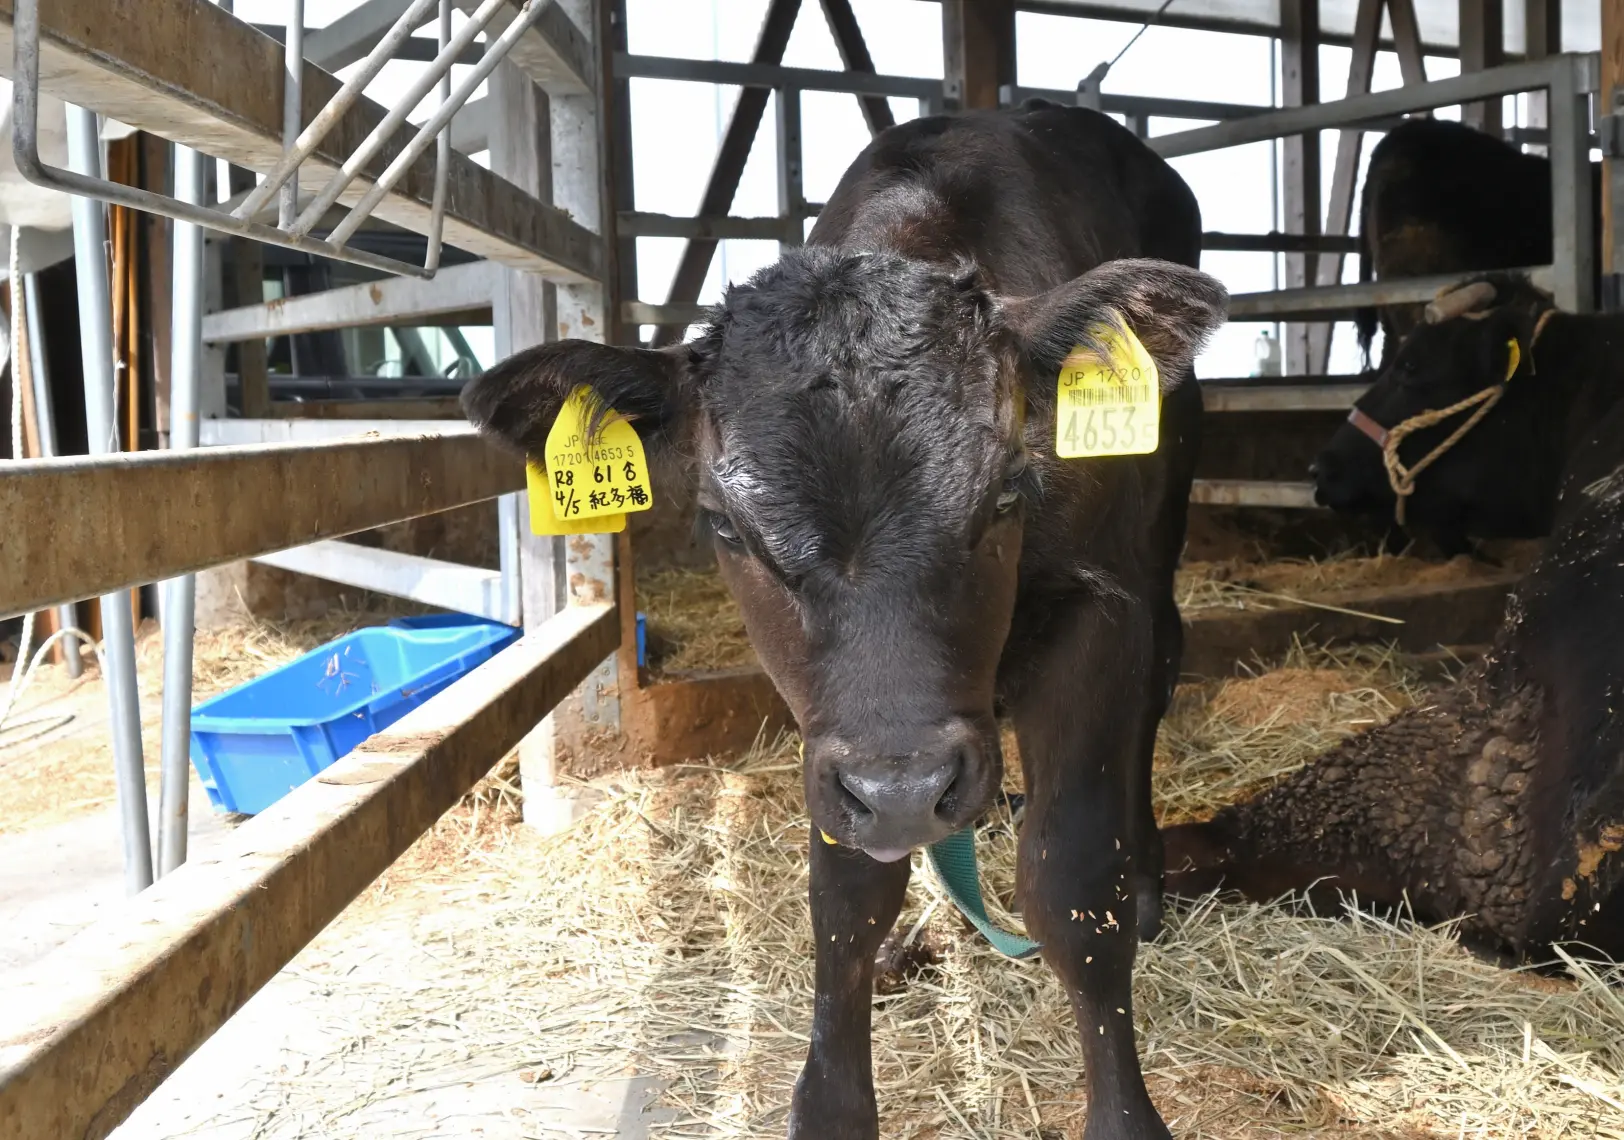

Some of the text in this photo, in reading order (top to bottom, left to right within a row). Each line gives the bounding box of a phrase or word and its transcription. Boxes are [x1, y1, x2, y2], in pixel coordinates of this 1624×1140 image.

[1063, 371, 1085, 387] JP
[564, 434, 579, 448] JP
[555, 465, 612, 488] R8 61
[556, 488, 581, 517] 4/5
